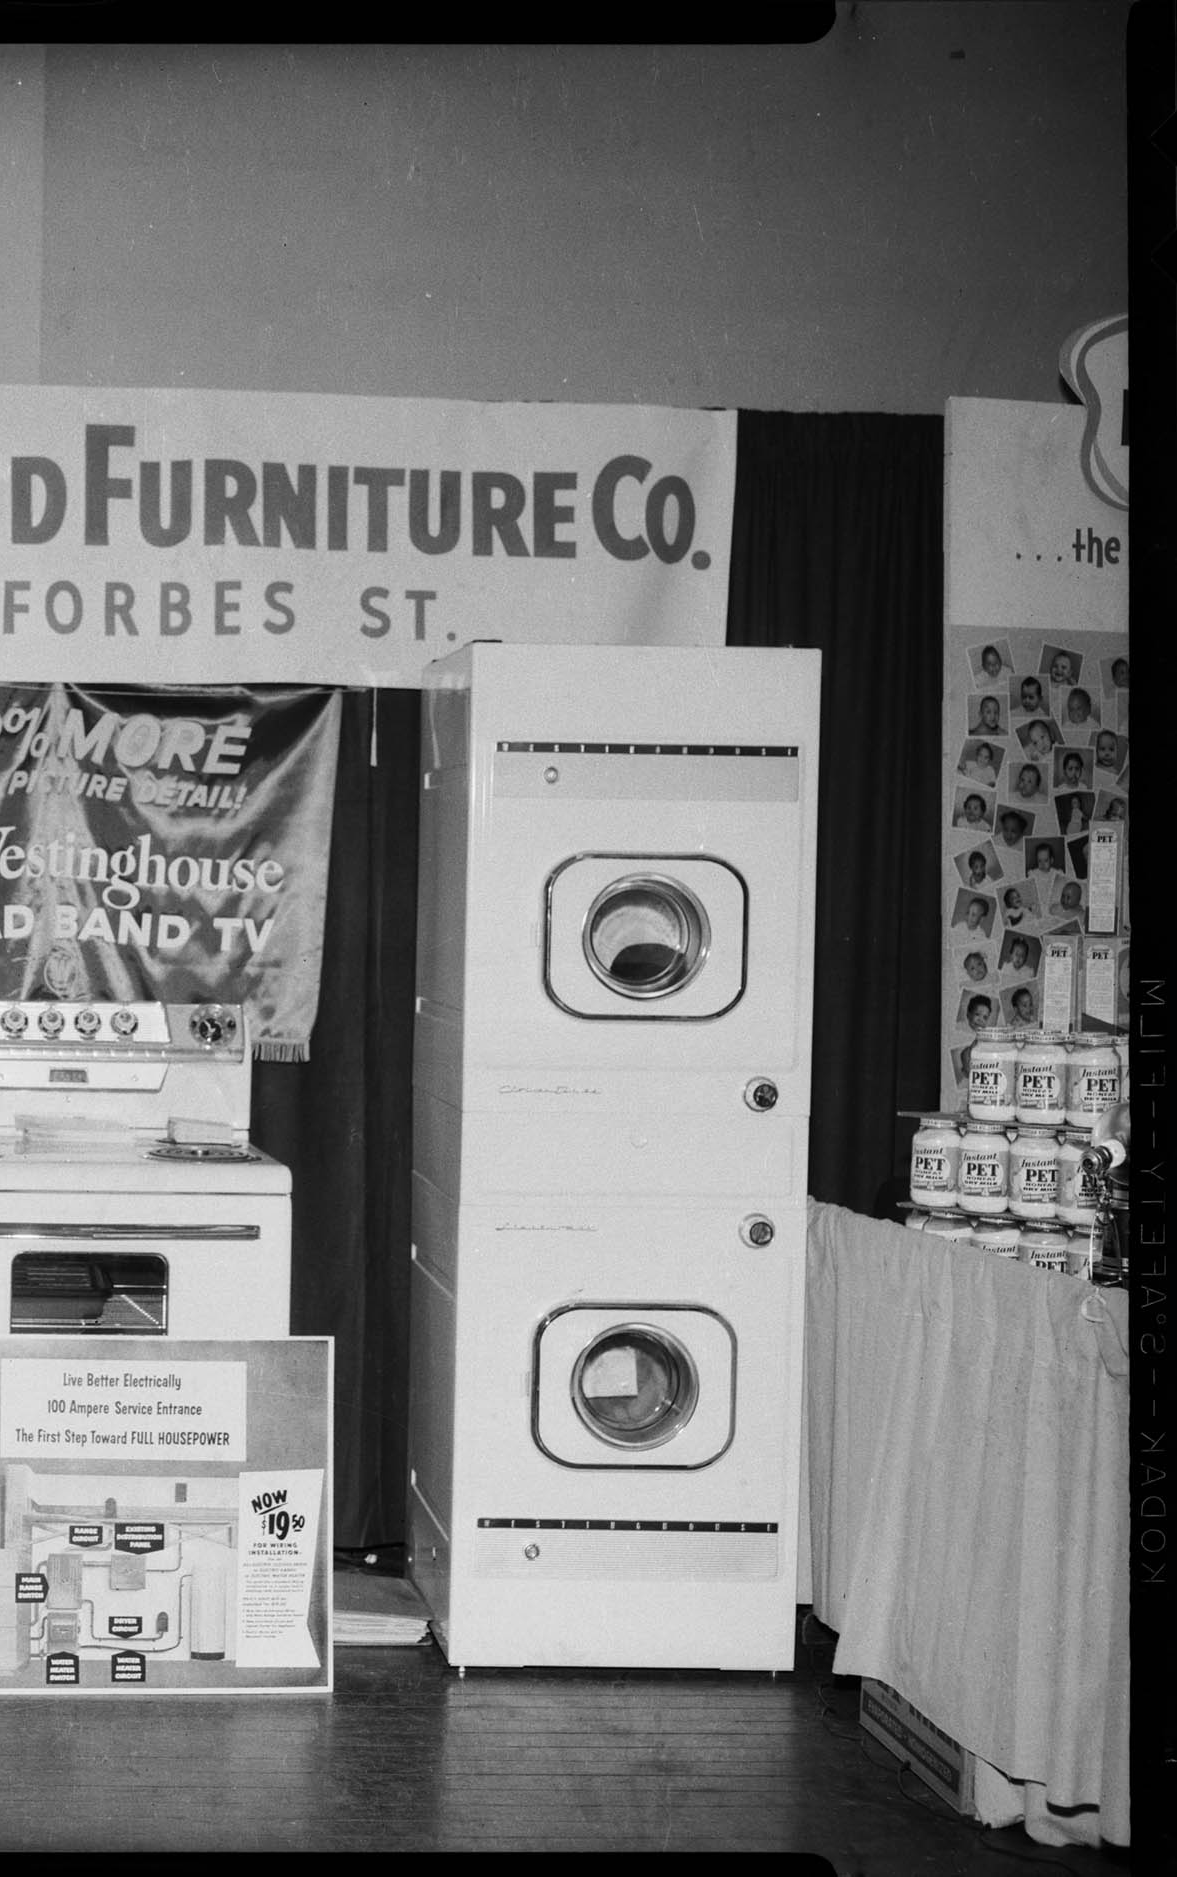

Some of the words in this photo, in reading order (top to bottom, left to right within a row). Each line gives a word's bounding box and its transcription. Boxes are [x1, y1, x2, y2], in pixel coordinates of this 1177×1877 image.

[84, 424, 578, 560] FURNITURE
[592, 454, 711, 571] CO.
[1072, 527, 1121, 568] the
[3, 578, 297, 637] FORBES
[360, 586, 456, 642] ST.
[55, 708, 252, 775] MORE
[7, 771, 128, 802] PICTURE
[135, 776, 249, 810] DETAIL!
[52, 906, 191, 948] BAND
[213, 917, 275, 953] TV
[972, 1071, 1003, 1085] PET
[1023, 1074, 1056, 1089] PET
[1087, 1078, 1118, 1092] PET
[915, 1156, 946, 1170] PET
[966, 1162, 1000, 1177] PET
[1025, 1168, 1059, 1182] PET
[63, 1373, 83, 1387] Live
[87, 1373, 120, 1388] Better
[123, 1373, 182, 1391] Electrically
[47, 1400, 66, 1414] 100
[69, 1401, 110, 1418] Ampere
[115, 1401, 153, 1415] Service
[156, 1402, 203, 1416] Entrance
[15, 1429, 34, 1443] The
[37, 1429, 61, 1444] First
[64, 1430, 88, 1447] Step
[91, 1431, 128, 1445] Toward
[131, 1432, 155, 1446] FULL
[158, 1432, 230, 1447] HOUSEPOWER
[251, 1489, 288, 1514] NOW
